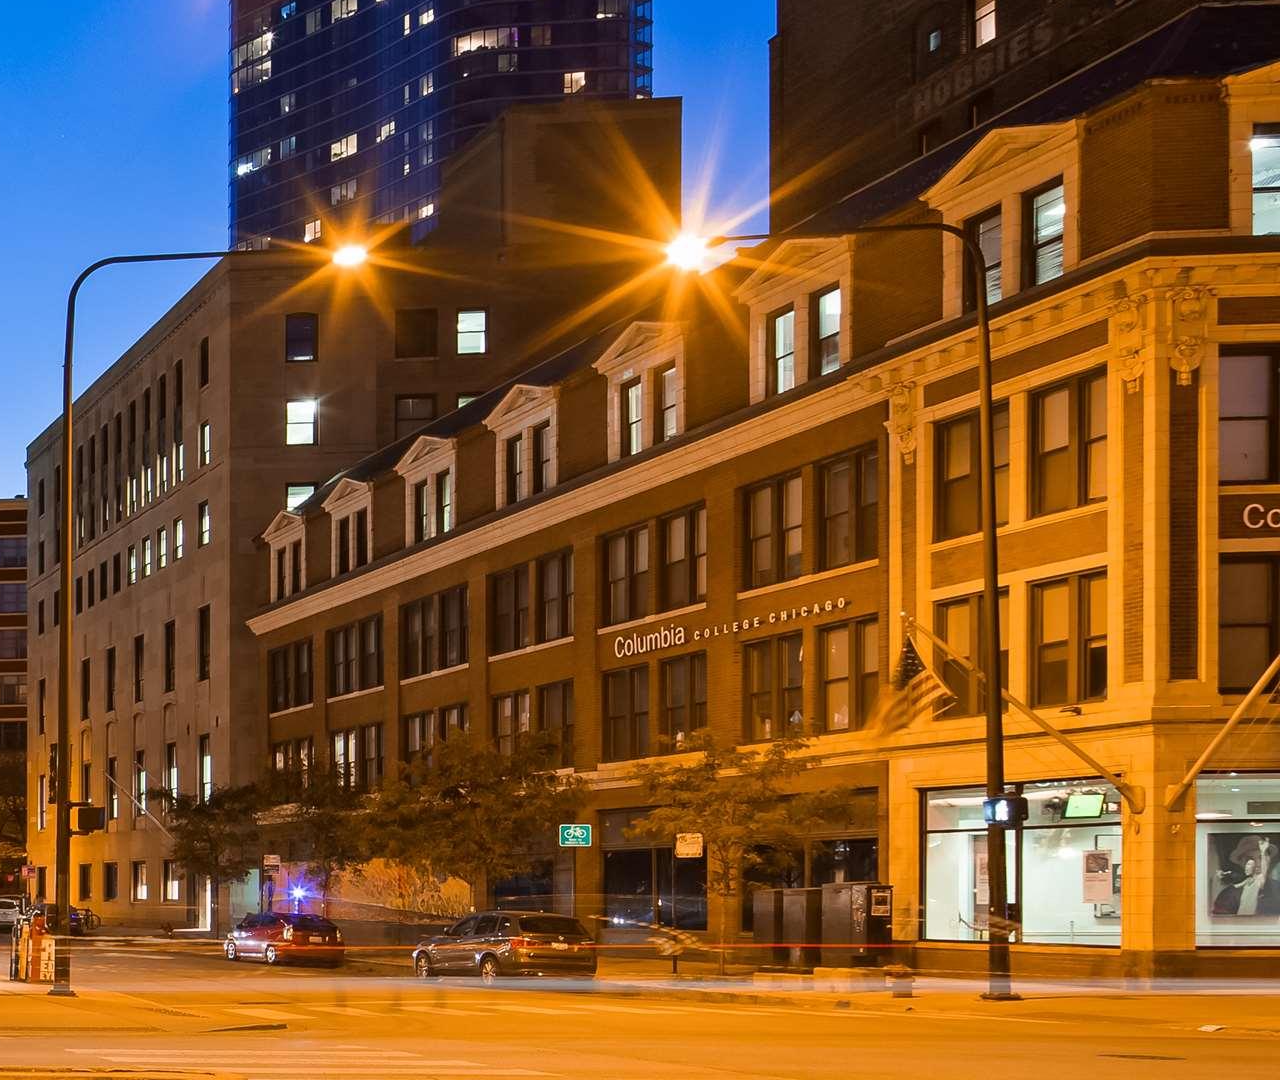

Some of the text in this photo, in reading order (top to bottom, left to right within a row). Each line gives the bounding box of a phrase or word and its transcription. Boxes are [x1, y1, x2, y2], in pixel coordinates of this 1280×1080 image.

[614, 597, 846, 658] Columbia COLLEGE CHICAGO
